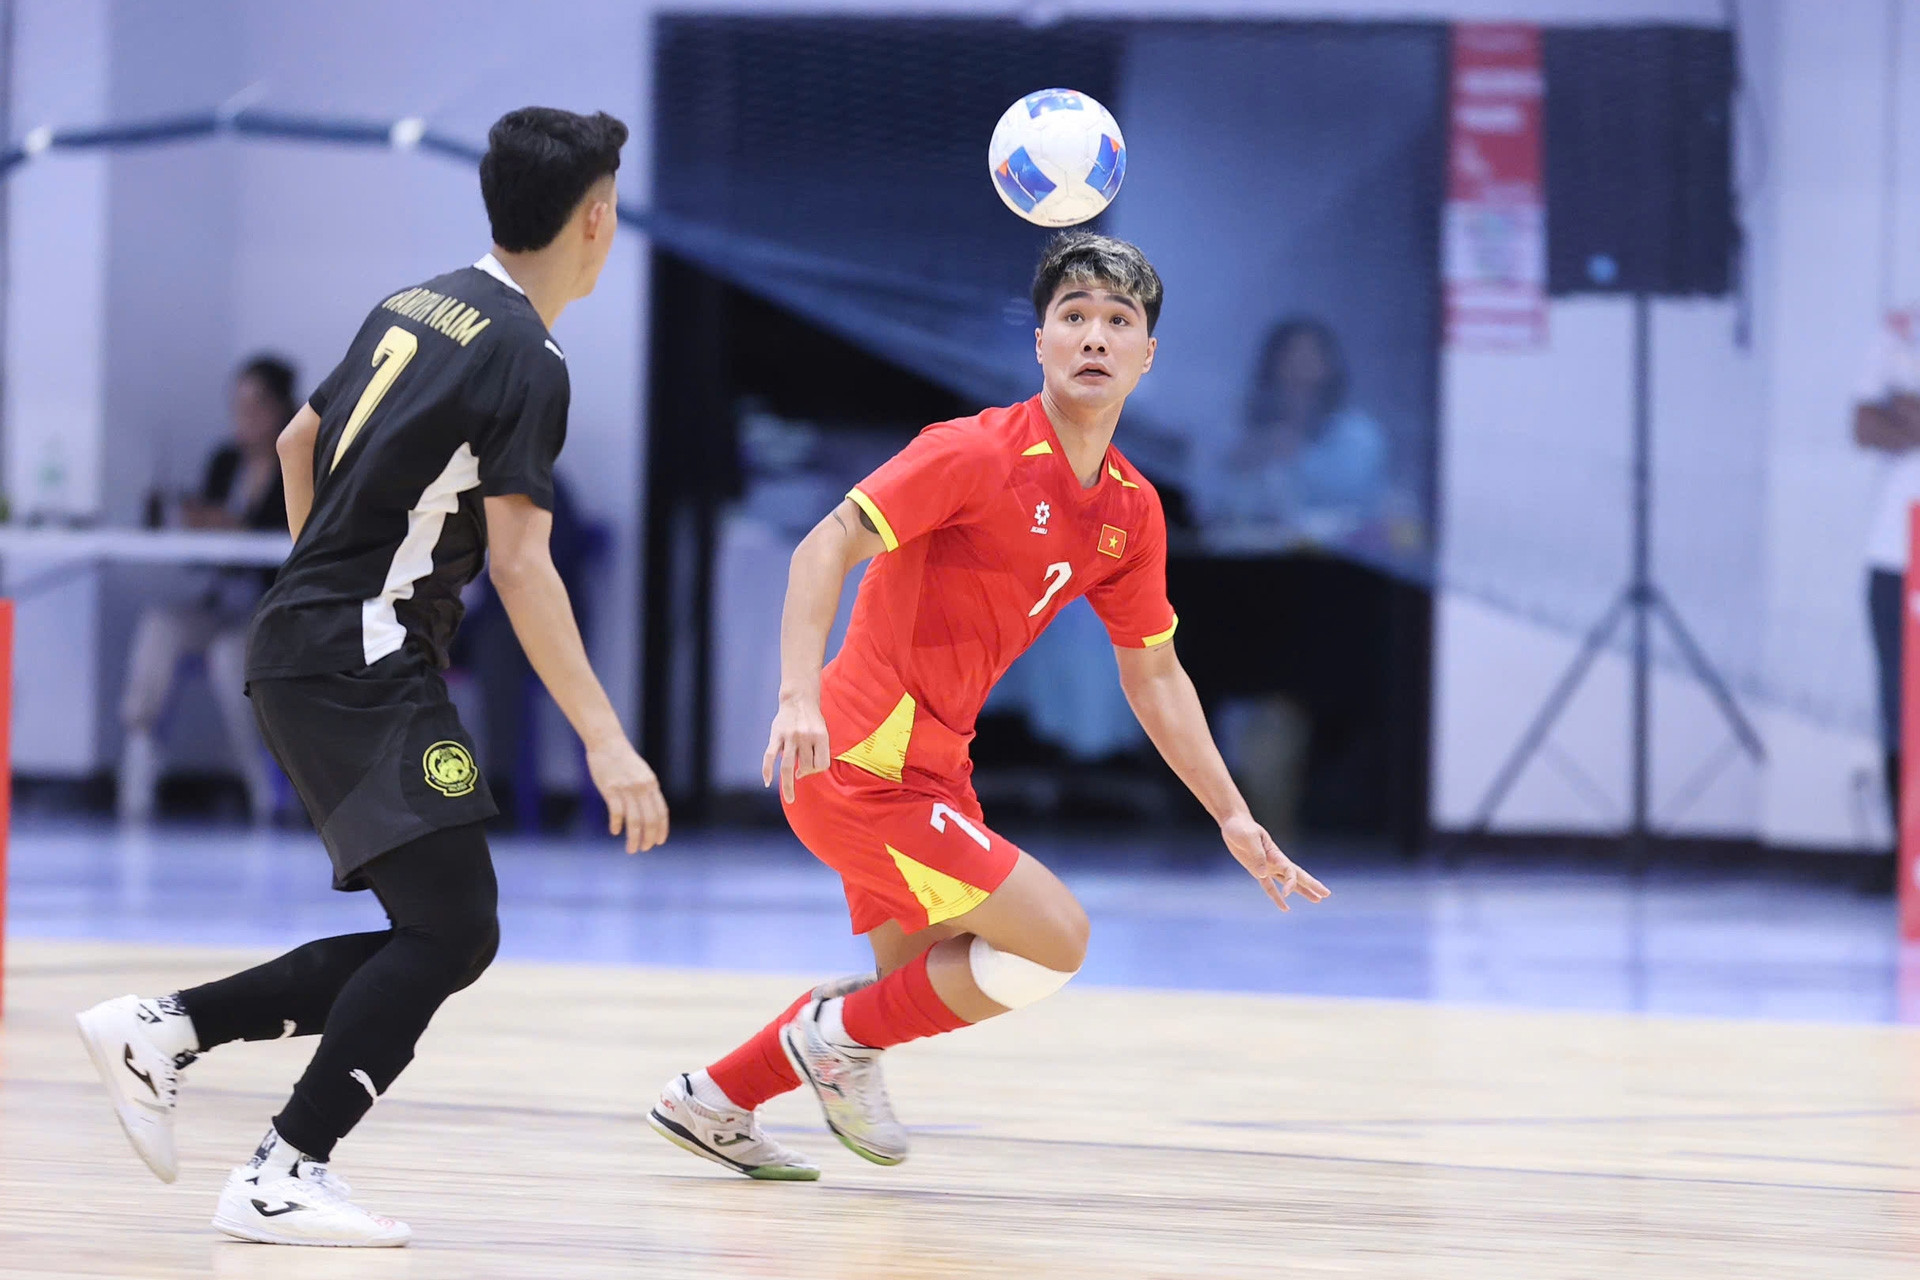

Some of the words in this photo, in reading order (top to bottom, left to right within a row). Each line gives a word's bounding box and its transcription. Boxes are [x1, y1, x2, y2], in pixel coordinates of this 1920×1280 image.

[329, 325, 418, 476] 7
[1028, 561, 1073, 617] 7
[929, 802, 991, 852] 7
